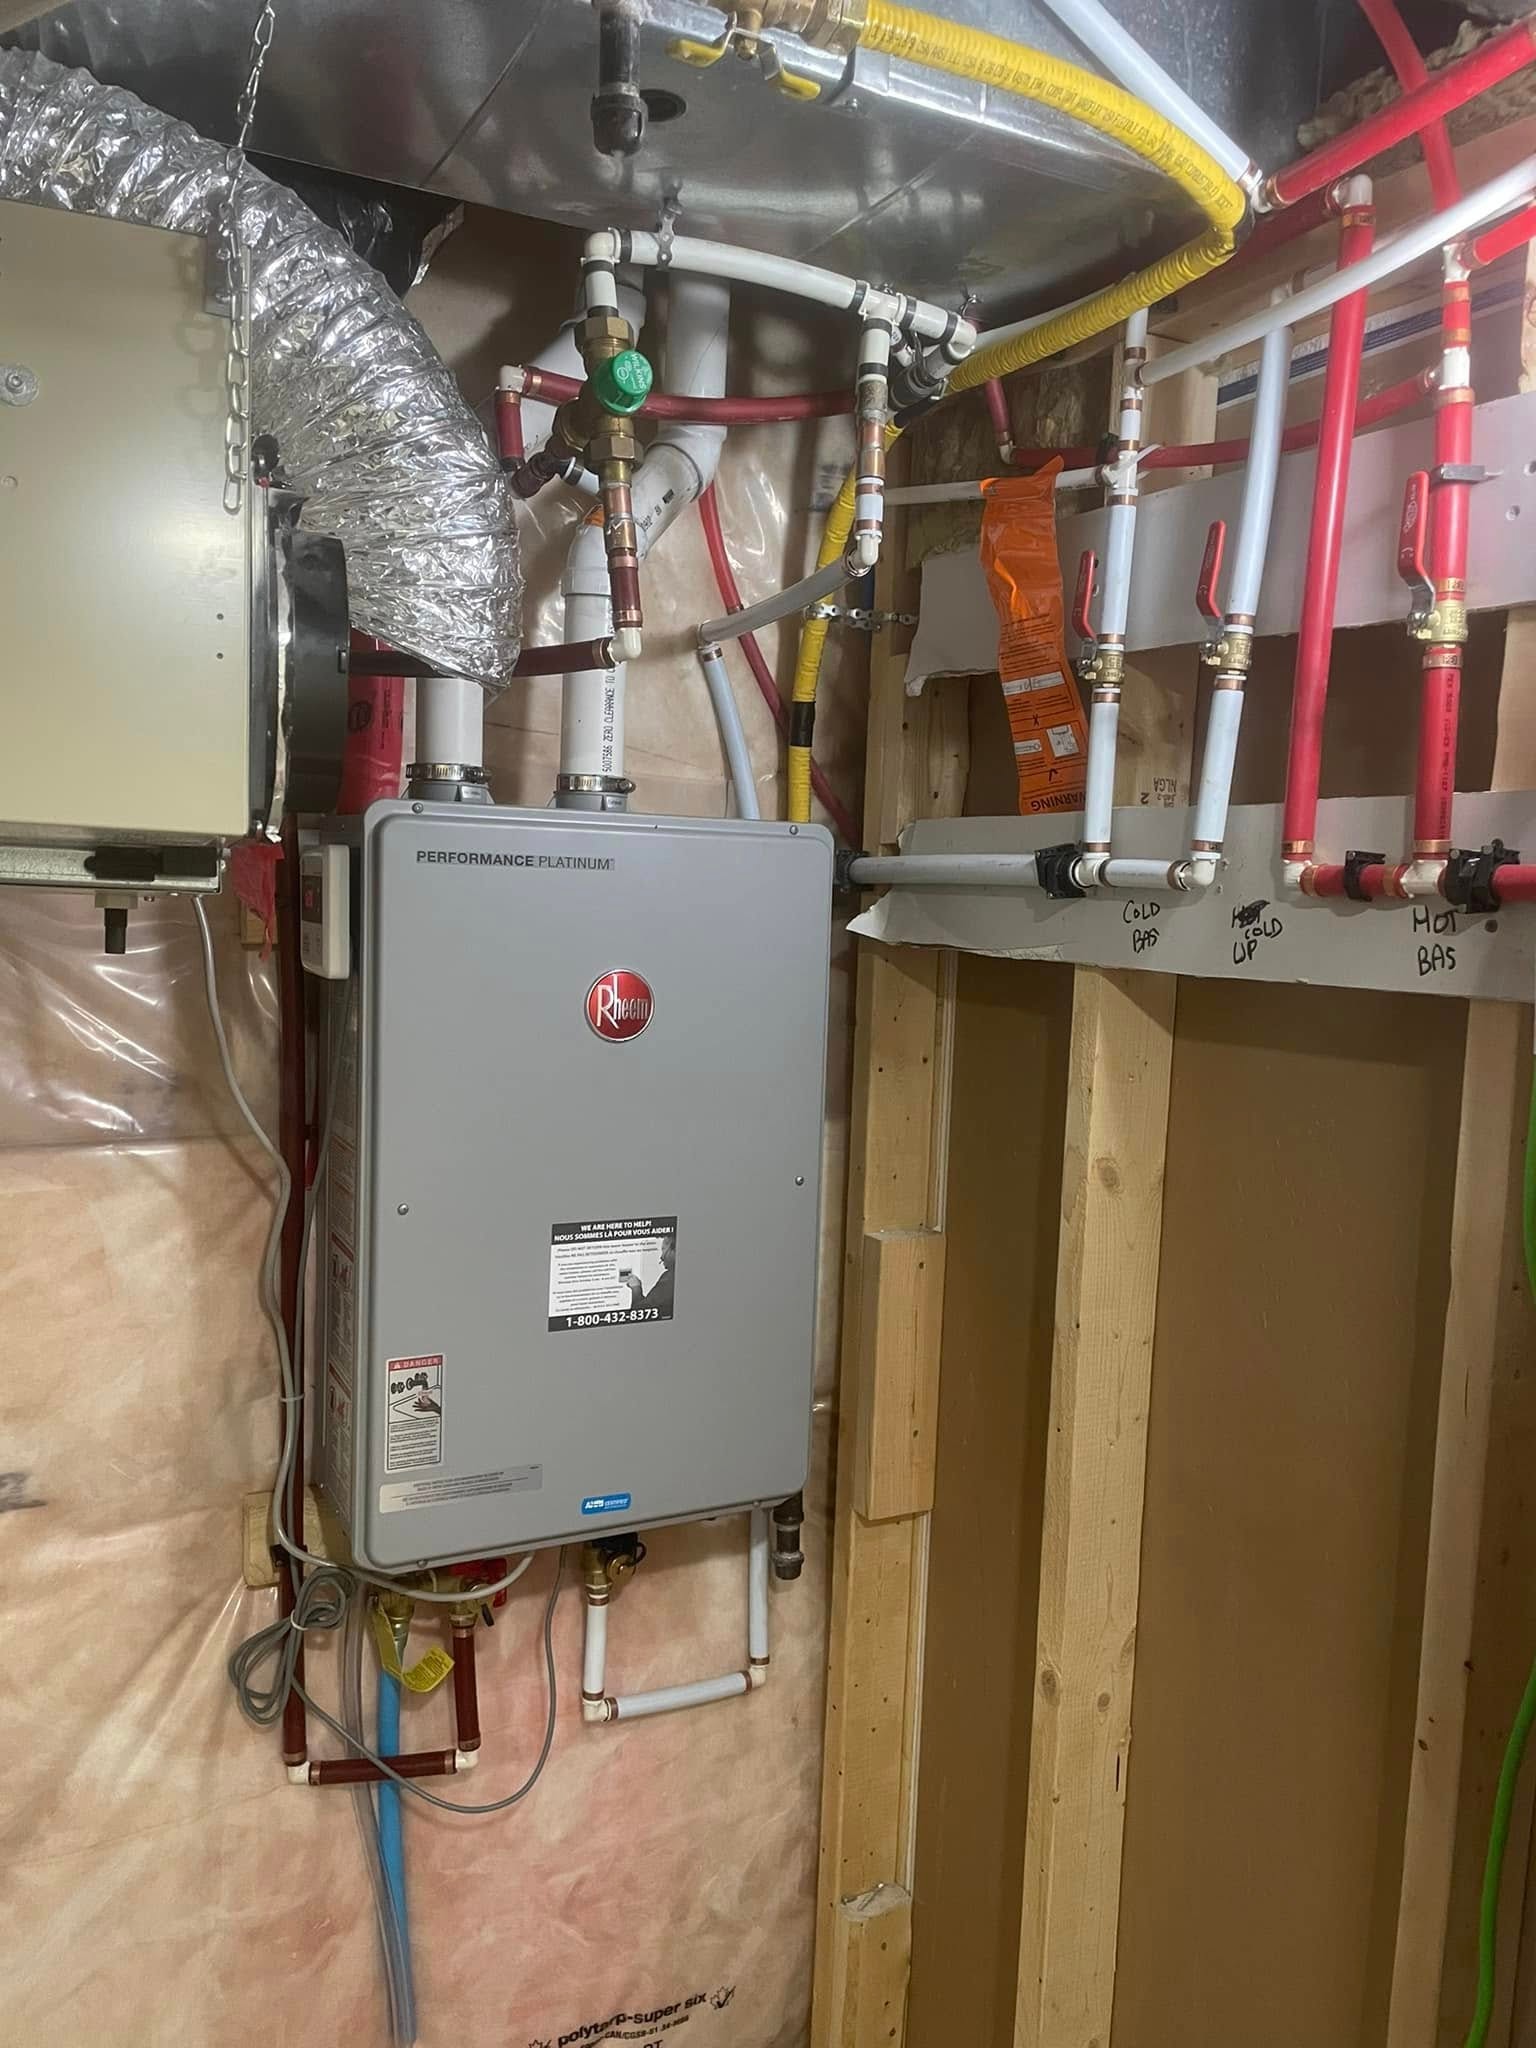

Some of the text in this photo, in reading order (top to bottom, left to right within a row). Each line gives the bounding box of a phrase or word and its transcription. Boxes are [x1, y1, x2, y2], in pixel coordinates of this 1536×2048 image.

[631, 353, 648, 390] WILKINS
[604, 687, 616, 723] CLEARANCE
[603, 725, 614, 743] ZERO
[1153, 777, 1177, 793] NLGA
[1140, 792, 1151, 805] 2
[416, 850, 613, 870] PERFORMANCE PLATINUM
[1122, 900, 1161, 924] COLD
[1412, 904, 1457, 934] HOT
[1132, 927, 1161, 954] BAS
[1244, 918, 1283, 940] COLD
[1233, 939, 1258, 965] UP
[1417, 943, 1457, 977] BAS
[596, 972, 649, 1030] Rheem
[553, 1233, 574, 1241] NOUS
[574, 1231, 604, 1240] SOMMES
[613, 1229, 632, 1238] POUR
[632, 1228, 650, 1236] VOUS
[651, 1227, 671, 1235] AIDER
[580, 1220, 652, 1232] WE ARE HERE TO HELP!
[566, 1308, 659, 1328] 1-800-432-8373
[403, 1357, 440, 1368] DANGER
[557, 1992, 707, 2048] polytarp-super six
